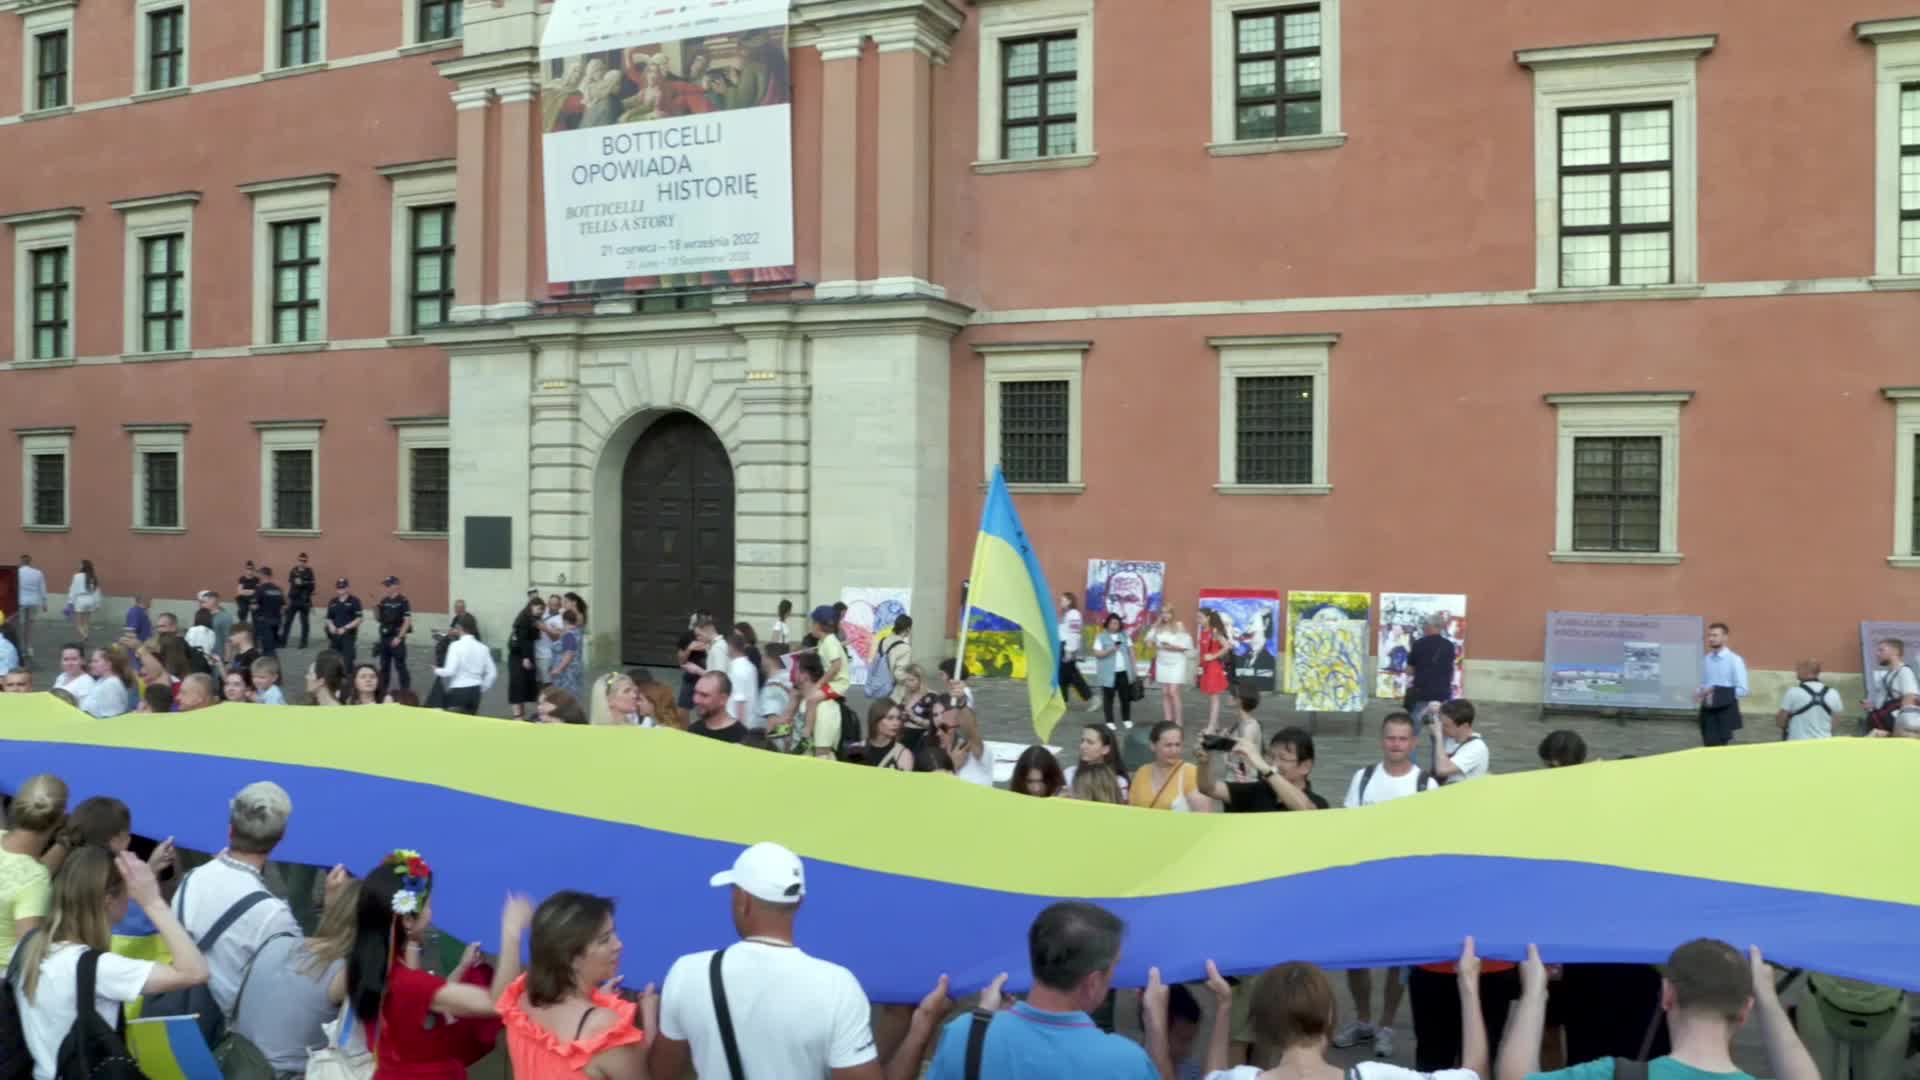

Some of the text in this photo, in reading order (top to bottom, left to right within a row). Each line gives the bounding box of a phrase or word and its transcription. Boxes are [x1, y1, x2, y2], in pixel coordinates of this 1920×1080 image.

[602, 123, 721, 156] BOTTICELLI
[571, 154, 692, 185] OPOWIADA
[657, 173, 759, 202] HISTORIĘ
[565, 199, 645, 219] BOTTICELLI
[579, 218, 617, 235] TELLS
[632, 214, 675, 231] STORY
[733, 231, 761, 246] 2022
